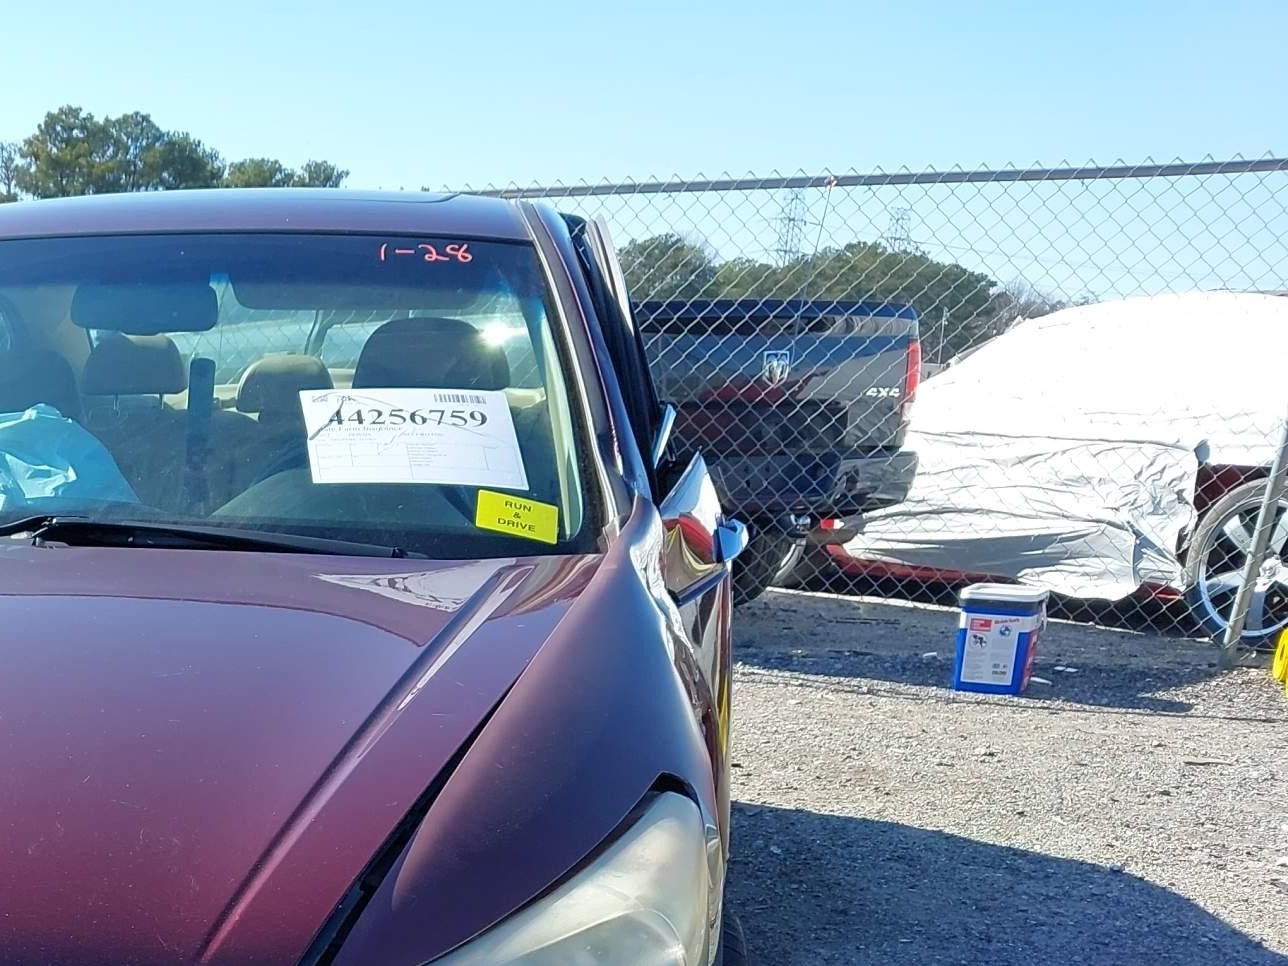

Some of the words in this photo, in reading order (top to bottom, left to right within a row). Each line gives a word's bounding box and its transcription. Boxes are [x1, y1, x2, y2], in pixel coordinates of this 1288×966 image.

[380, 243, 473, 262] 1-28
[329, 408, 488, 427] 44256759
[504, 500, 532, 512] RUN
[512, 511, 521, 519] &
[497, 517, 536, 533] DRIVE
